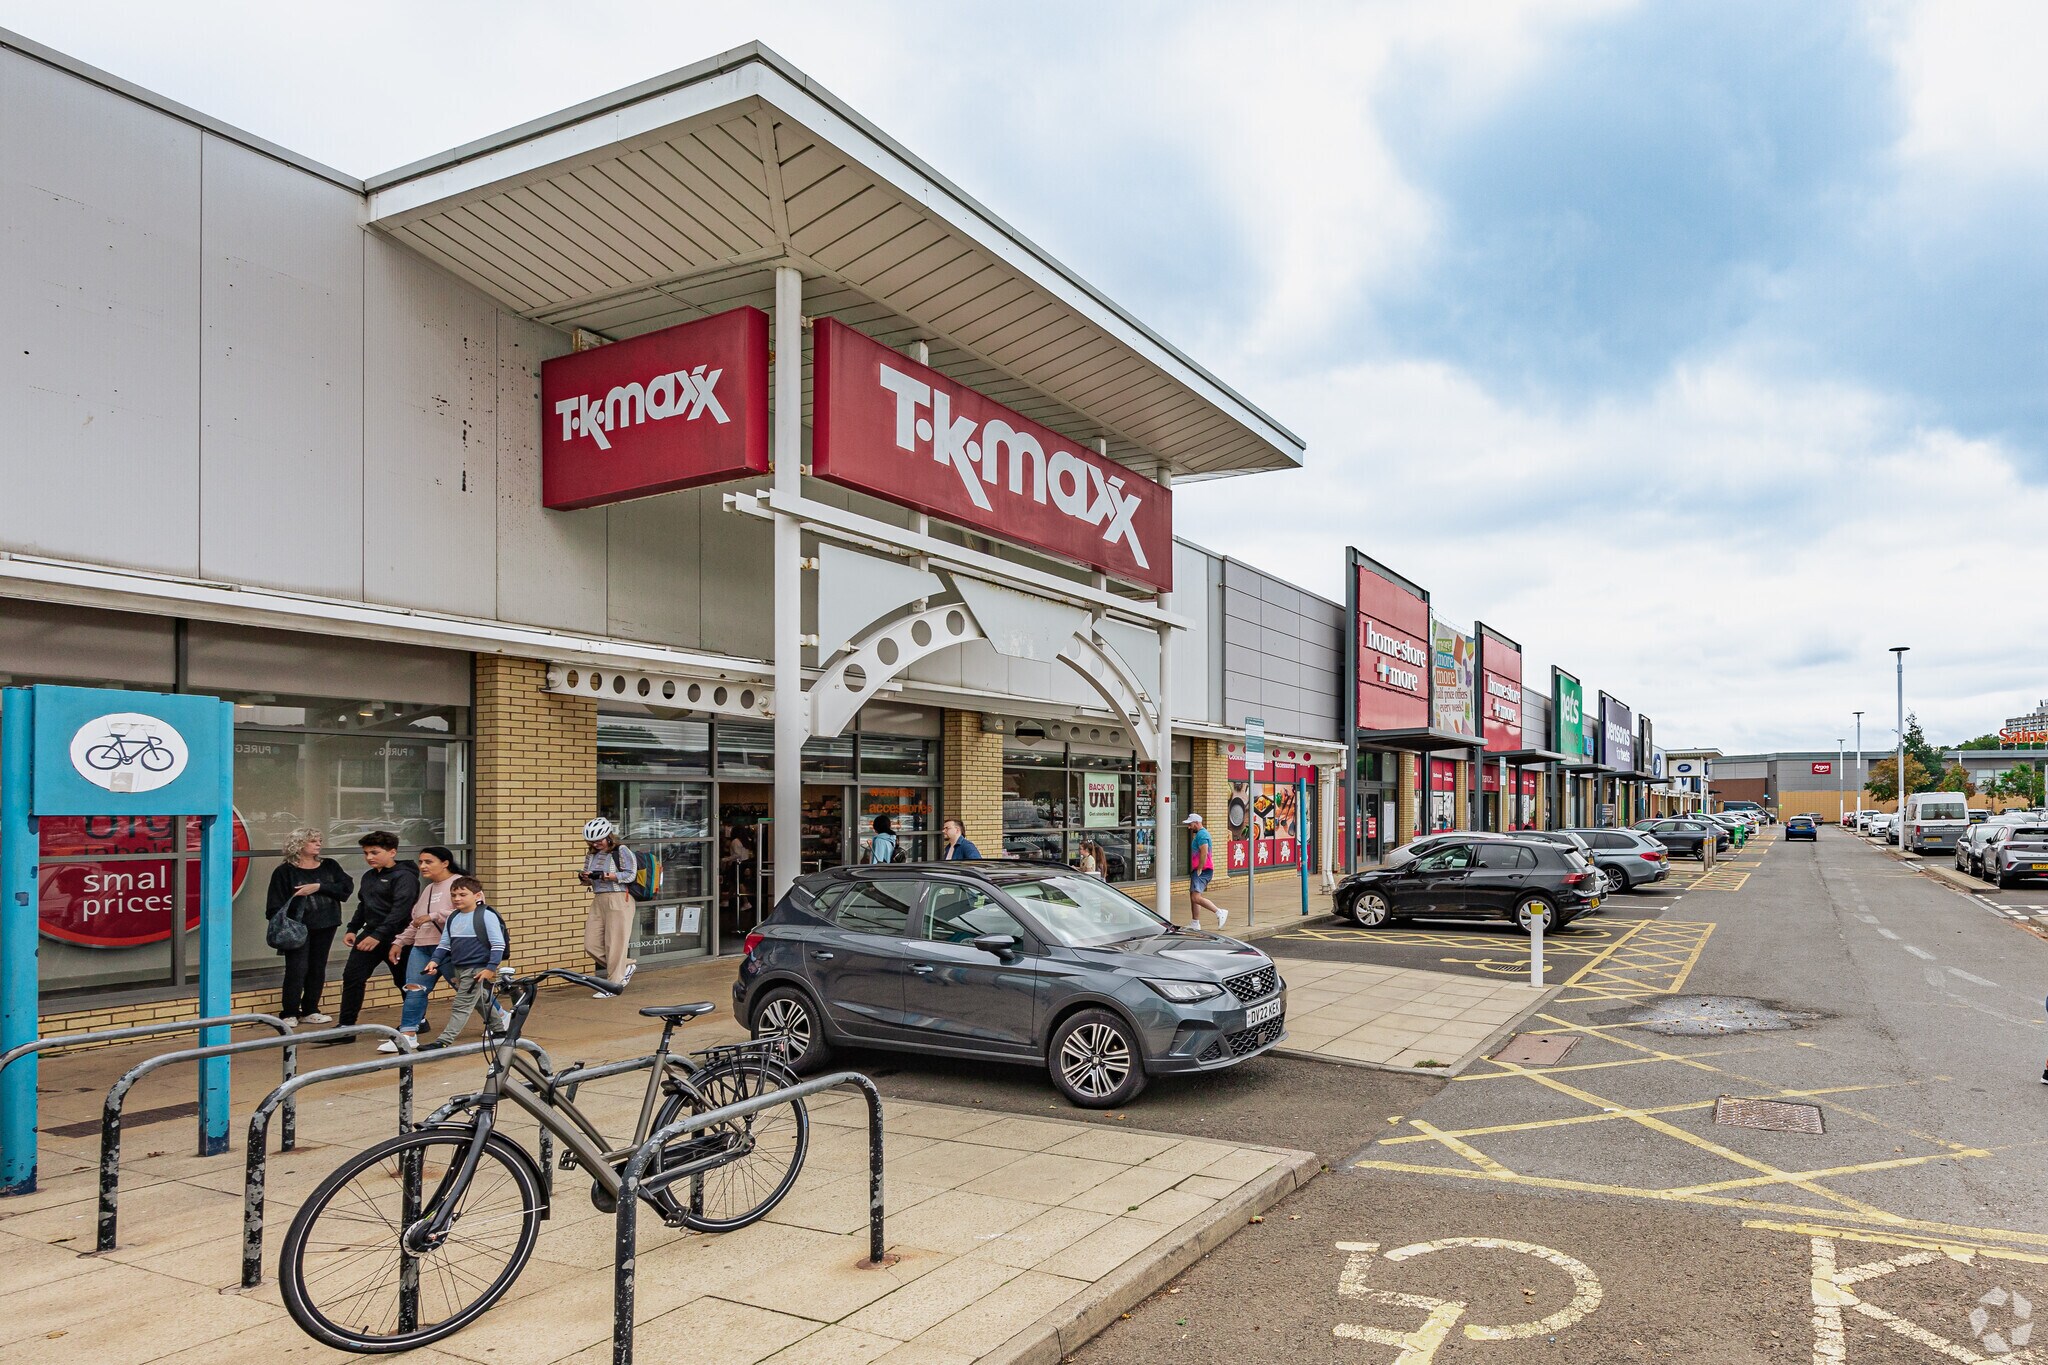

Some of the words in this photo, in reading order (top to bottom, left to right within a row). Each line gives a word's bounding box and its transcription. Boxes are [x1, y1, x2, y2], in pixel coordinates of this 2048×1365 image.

[1363, 620, 1426, 668] homestore
[1437, 654, 1454, 668] more
[1436, 670, 1456, 685] more
[1561, 690, 1579, 725] pets
[1606, 712, 1630, 747] bensons
[1999, 726, 2048, 745] Sains
[1089, 783, 1105, 791] BACK
[868, 803, 933, 814] accessories
[1089, 792, 1115, 808] UNI
[84, 866, 166, 893] smal
[83, 892, 172, 922] prices
